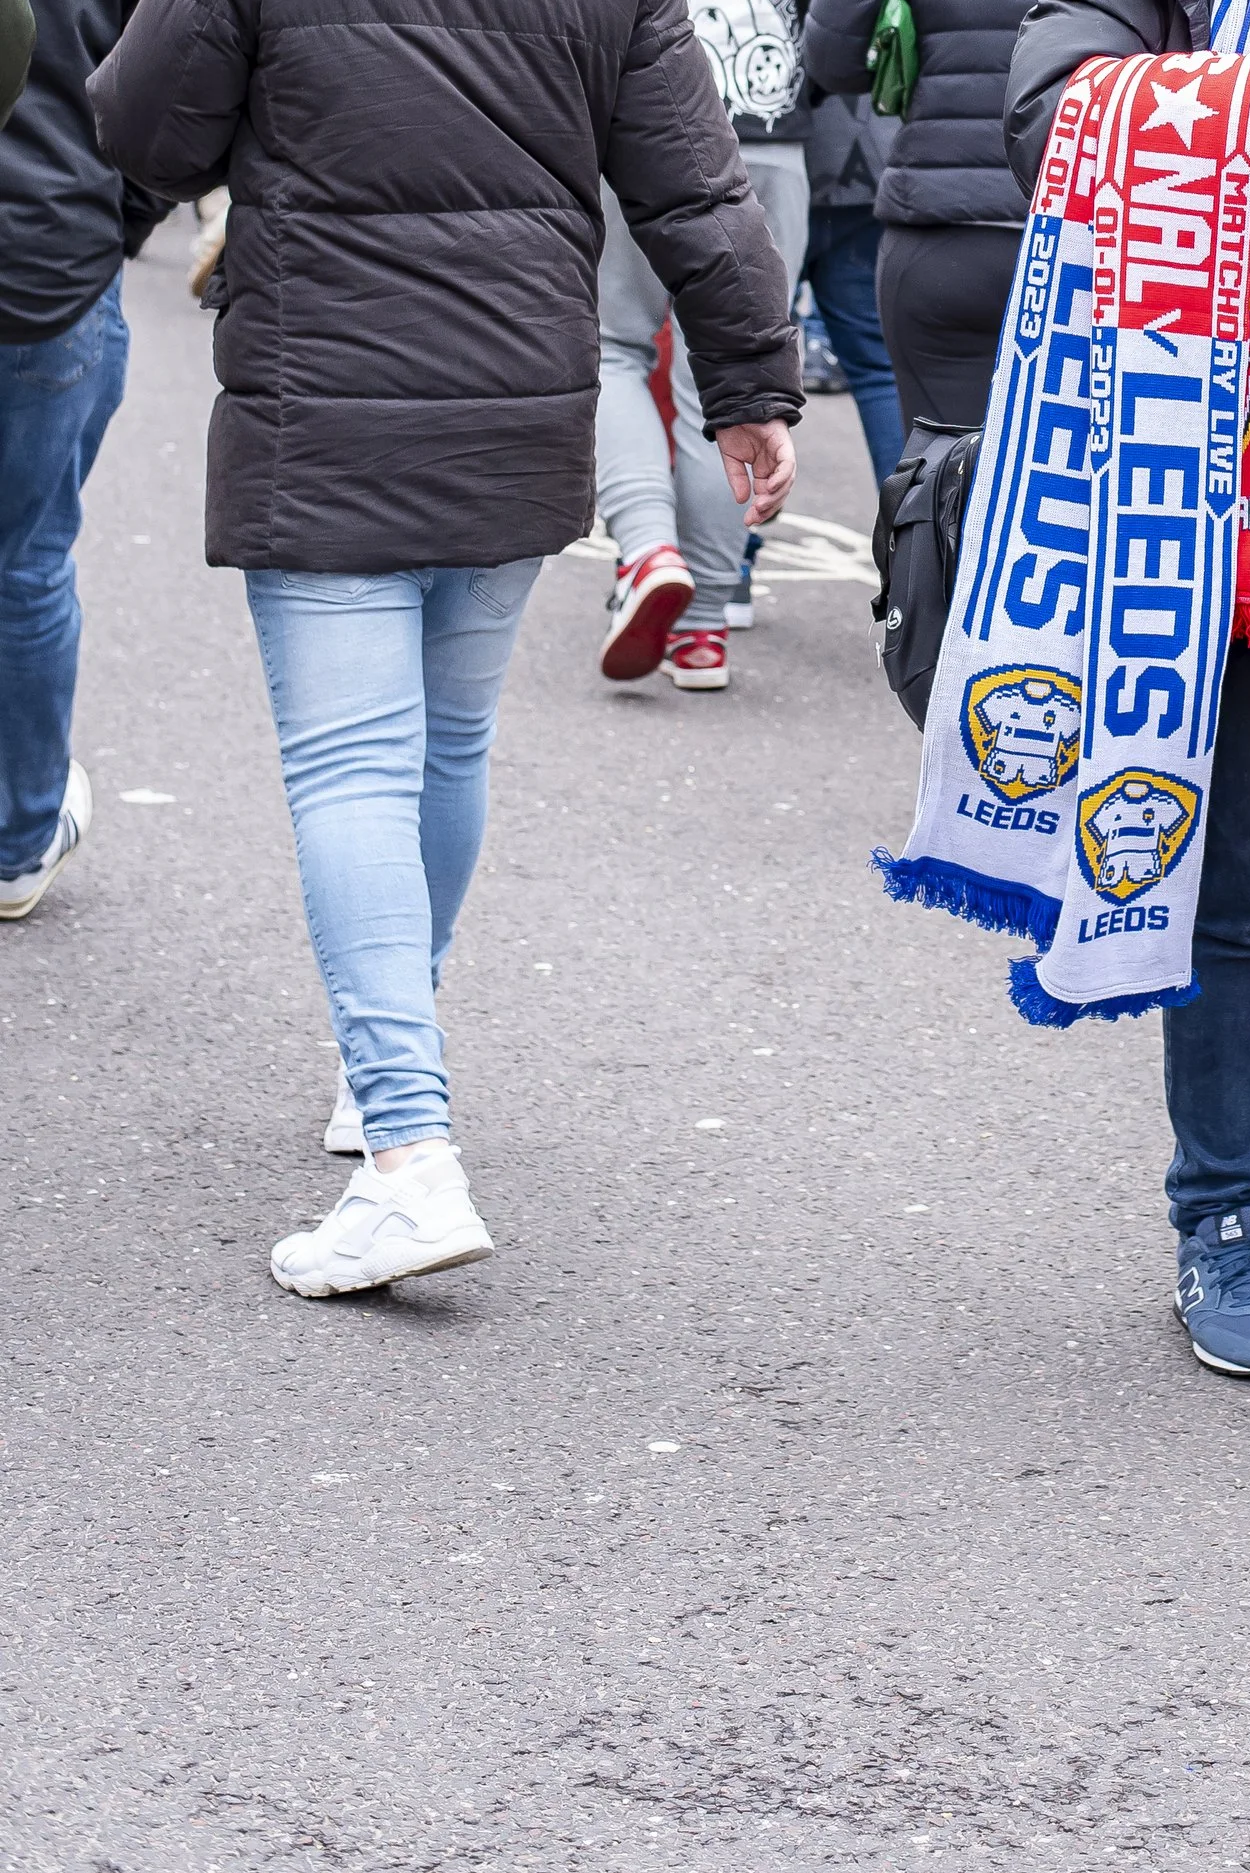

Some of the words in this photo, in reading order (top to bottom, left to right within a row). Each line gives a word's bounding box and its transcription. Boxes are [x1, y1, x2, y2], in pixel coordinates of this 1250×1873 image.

[1021, 97, 1083, 338] 01-04-2023
[1212, 172, 1248, 393] MATCHDAY
[1091, 207, 1118, 454] 01-04-2023
[1103, 371, 1203, 740] LEEDS
[1208, 410, 1235, 495] LIVE
[956, 793, 1061, 835] LEEDS
[1077, 905, 1170, 944] LEEDS
